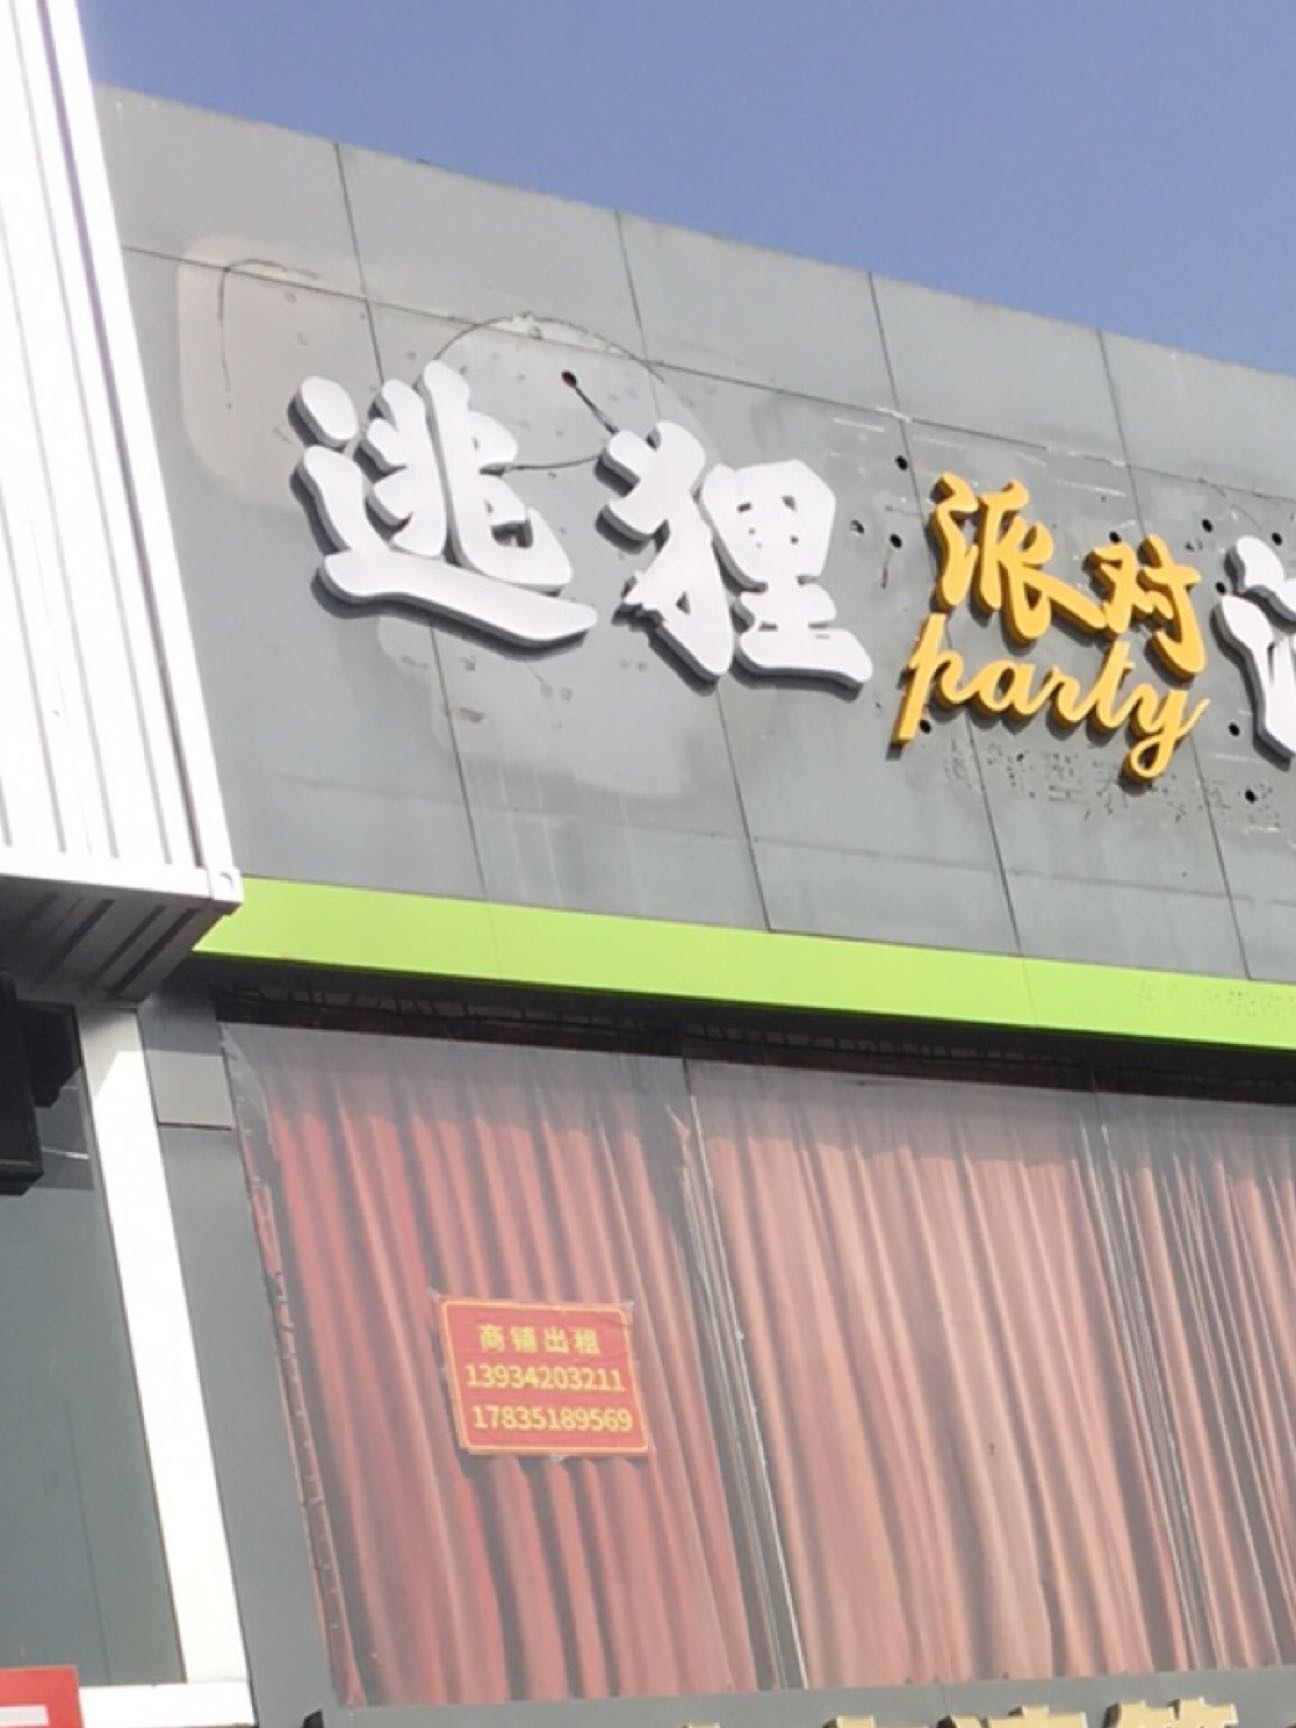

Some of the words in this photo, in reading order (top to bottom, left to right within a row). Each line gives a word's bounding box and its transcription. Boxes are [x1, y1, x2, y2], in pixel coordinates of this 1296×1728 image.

[290, 361, 874, 690] 逃狸
[932, 472, 1207, 678] 派对
[890, 614, 1210, 782] party
[466, 1364, 626, 1392] 13934203211
